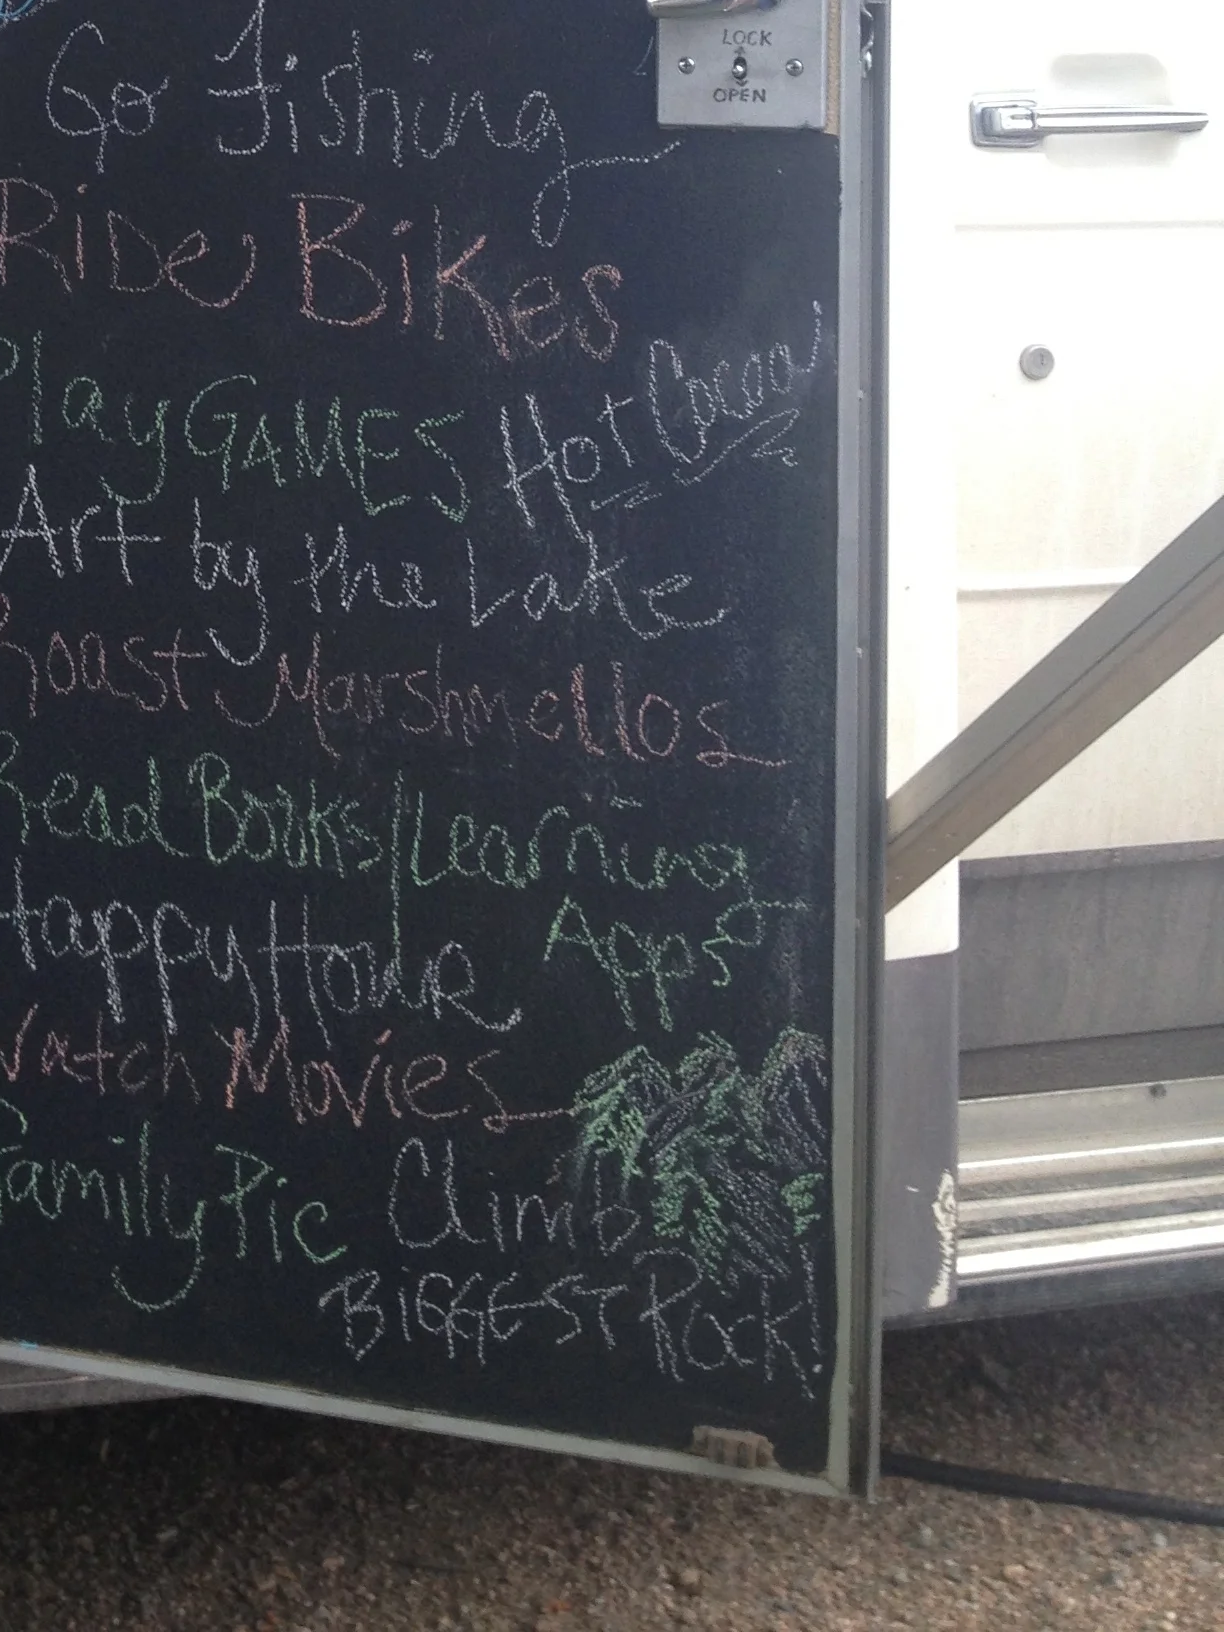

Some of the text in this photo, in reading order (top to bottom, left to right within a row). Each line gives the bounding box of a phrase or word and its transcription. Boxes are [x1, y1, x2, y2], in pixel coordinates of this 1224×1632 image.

[45, 21, 171, 173] Go
[713, 87, 767, 105] OPEN
[722, 29, 774, 46] LOCK
[184, 374, 472, 524] GAMES
[192, 497, 271, 667] by
[292, 522, 439, 614] the
